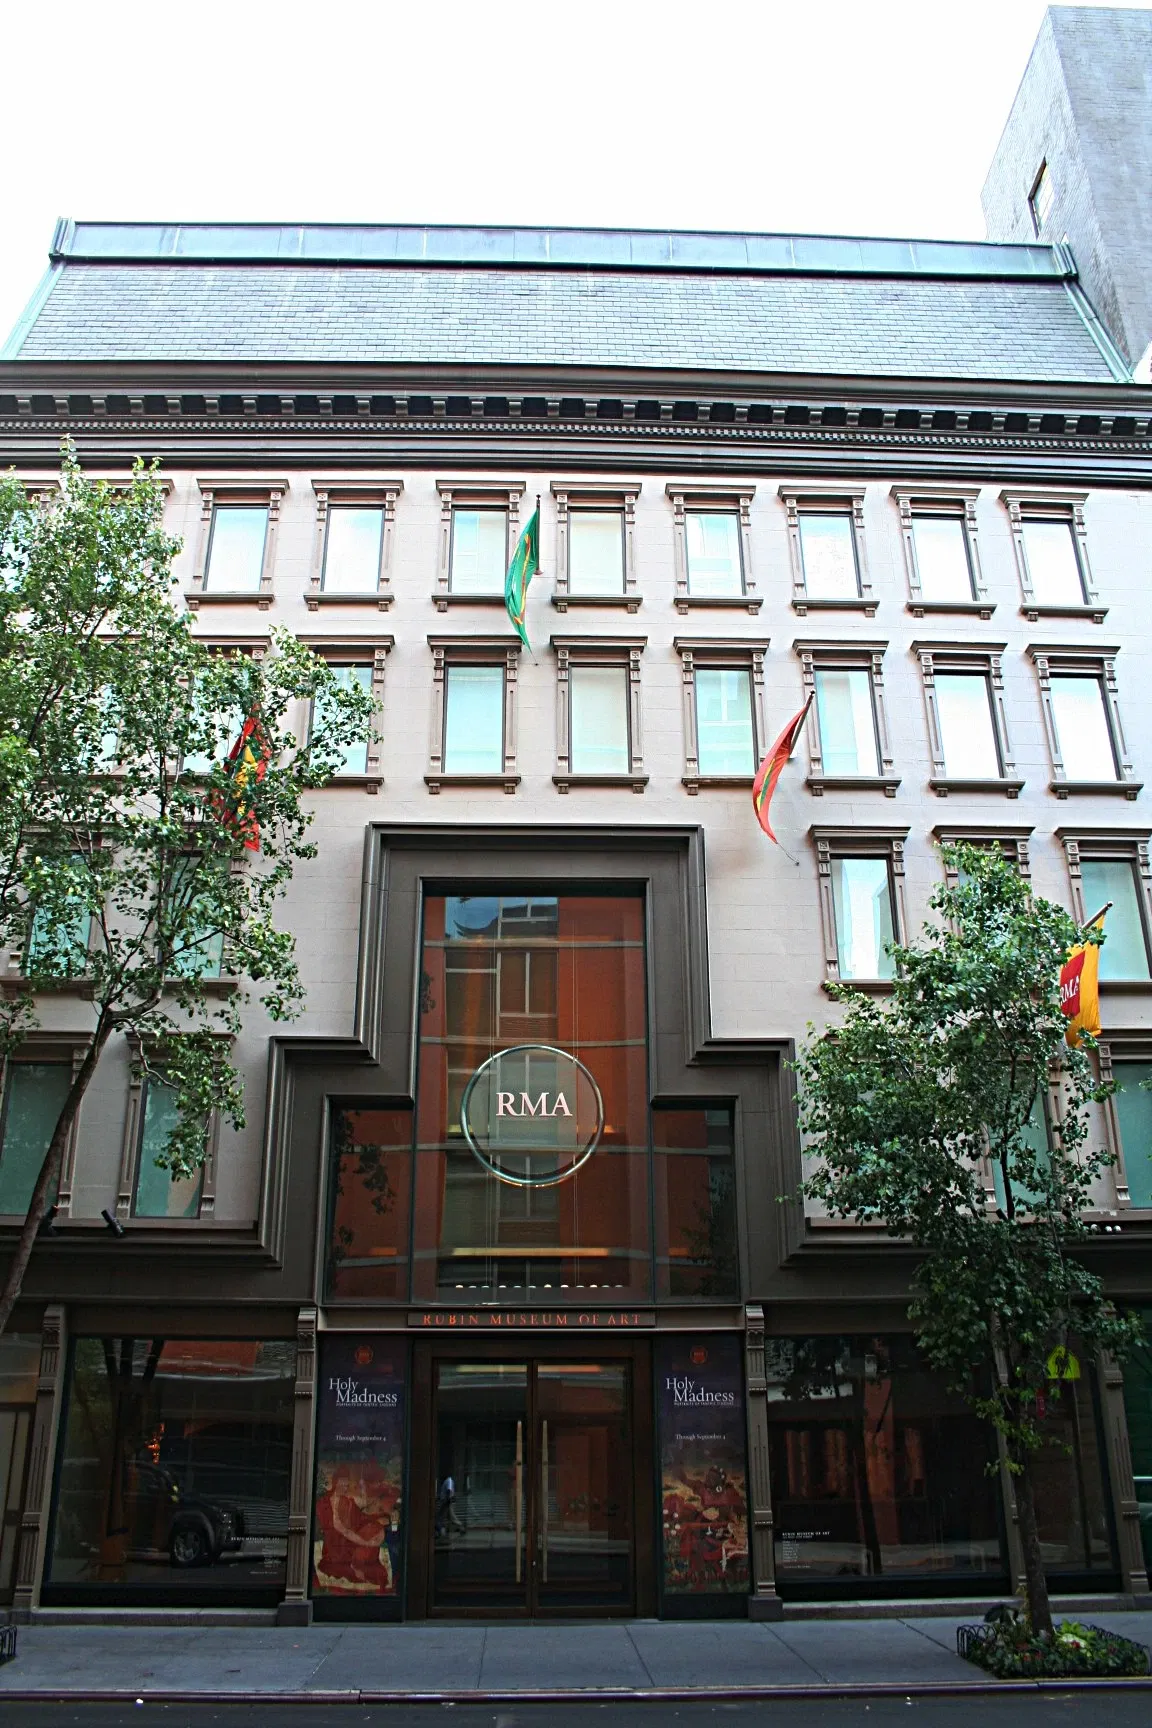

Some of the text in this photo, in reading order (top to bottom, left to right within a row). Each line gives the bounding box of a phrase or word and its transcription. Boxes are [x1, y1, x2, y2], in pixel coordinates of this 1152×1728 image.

[495, 1091, 573, 1117] RMA
[422, 1313, 641, 1326] RUBIN MUSEUM OF ART
[329, 1377, 359, 1393] Holy
[666, 1376, 695, 1392] Holy
[336, 1388, 398, 1403] Madness
[674, 1387, 735, 1402] Madness
[335, 1434, 356, 1443] Through
[357, 1434, 382, 1443] September
[697, 1433, 721, 1441] September
